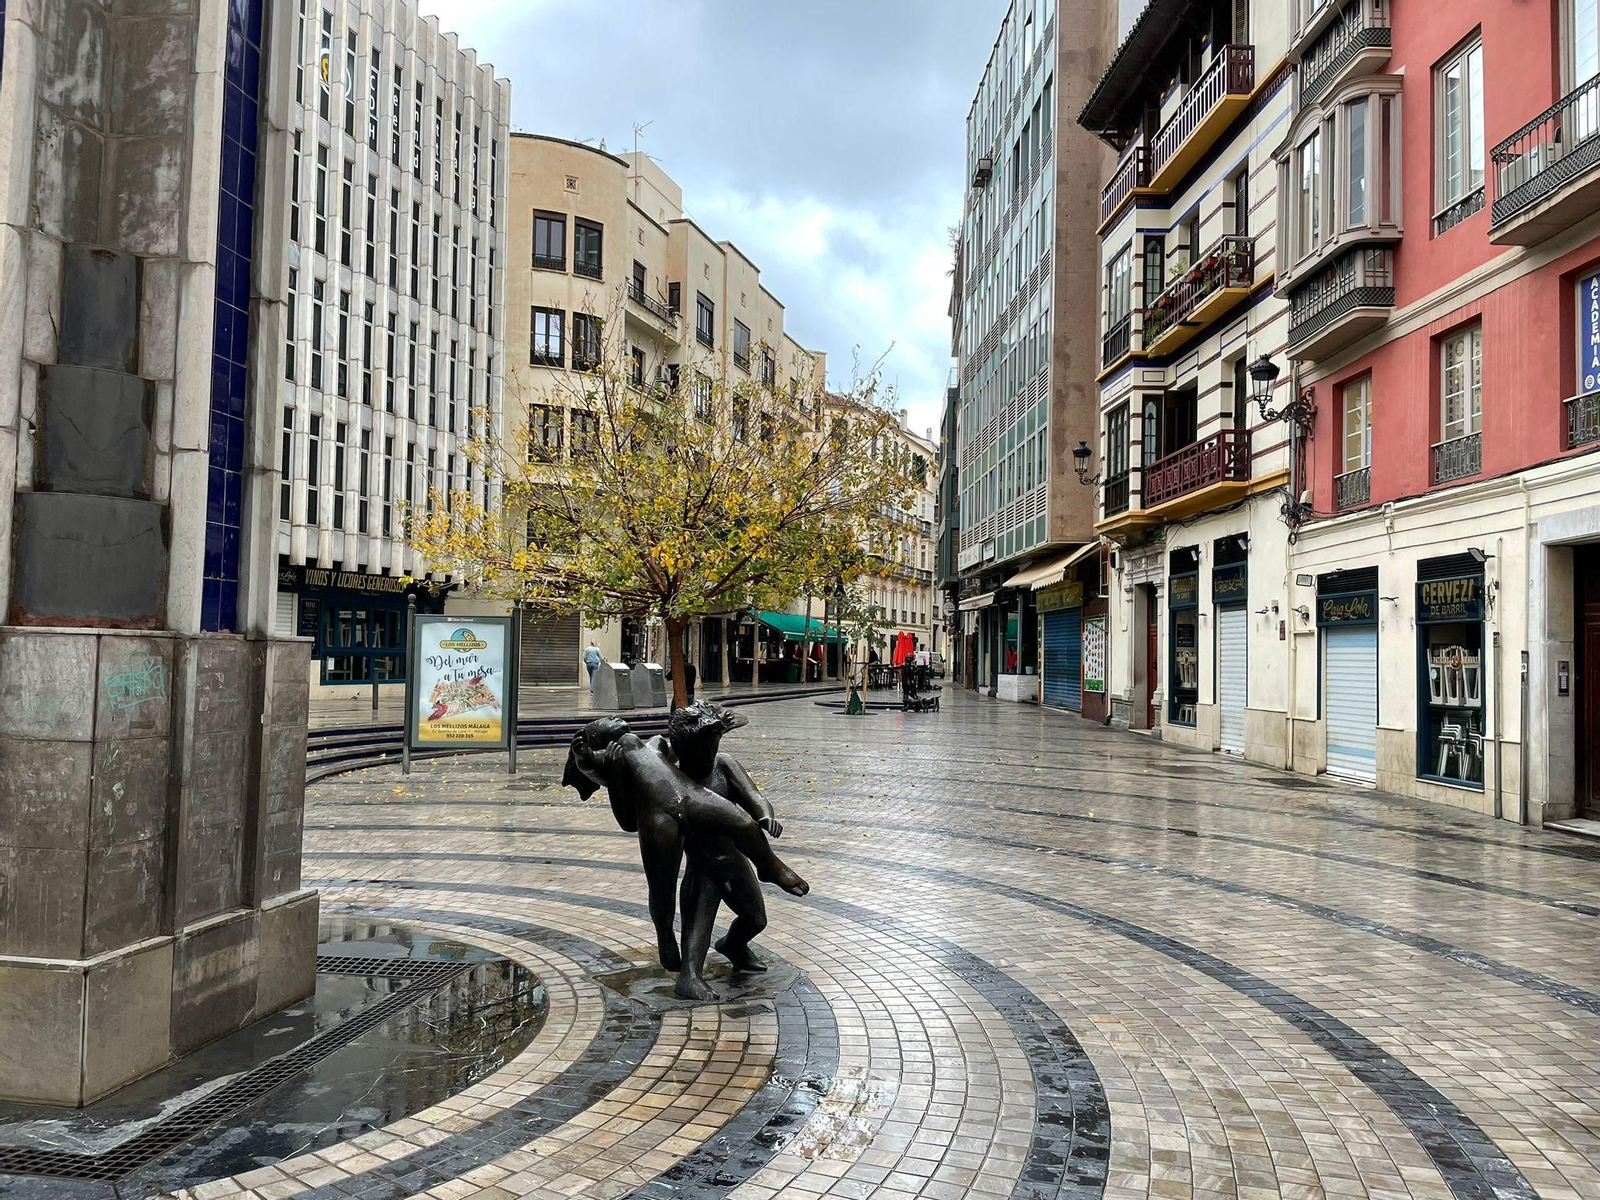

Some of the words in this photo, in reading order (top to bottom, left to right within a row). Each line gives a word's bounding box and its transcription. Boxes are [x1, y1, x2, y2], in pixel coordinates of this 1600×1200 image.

[1590, 277, 1600, 369] ACADEMIA
[305, 568, 330, 587] VINOS
[330, 571, 337, 587] Y
[337, 572, 368, 589] LICORES
[367, 574, 405, 593] GENEROSOS
[1323, 599, 1344, 620] Casa
[1344, 597, 1370, 619] Lola
[1430, 605, 1440, 616] DE
[1441, 603, 1467, 615] BARRIL
[425, 654, 452, 670] Del
[455, 653, 479, 665] mar
[443, 673, 451, 681] a
